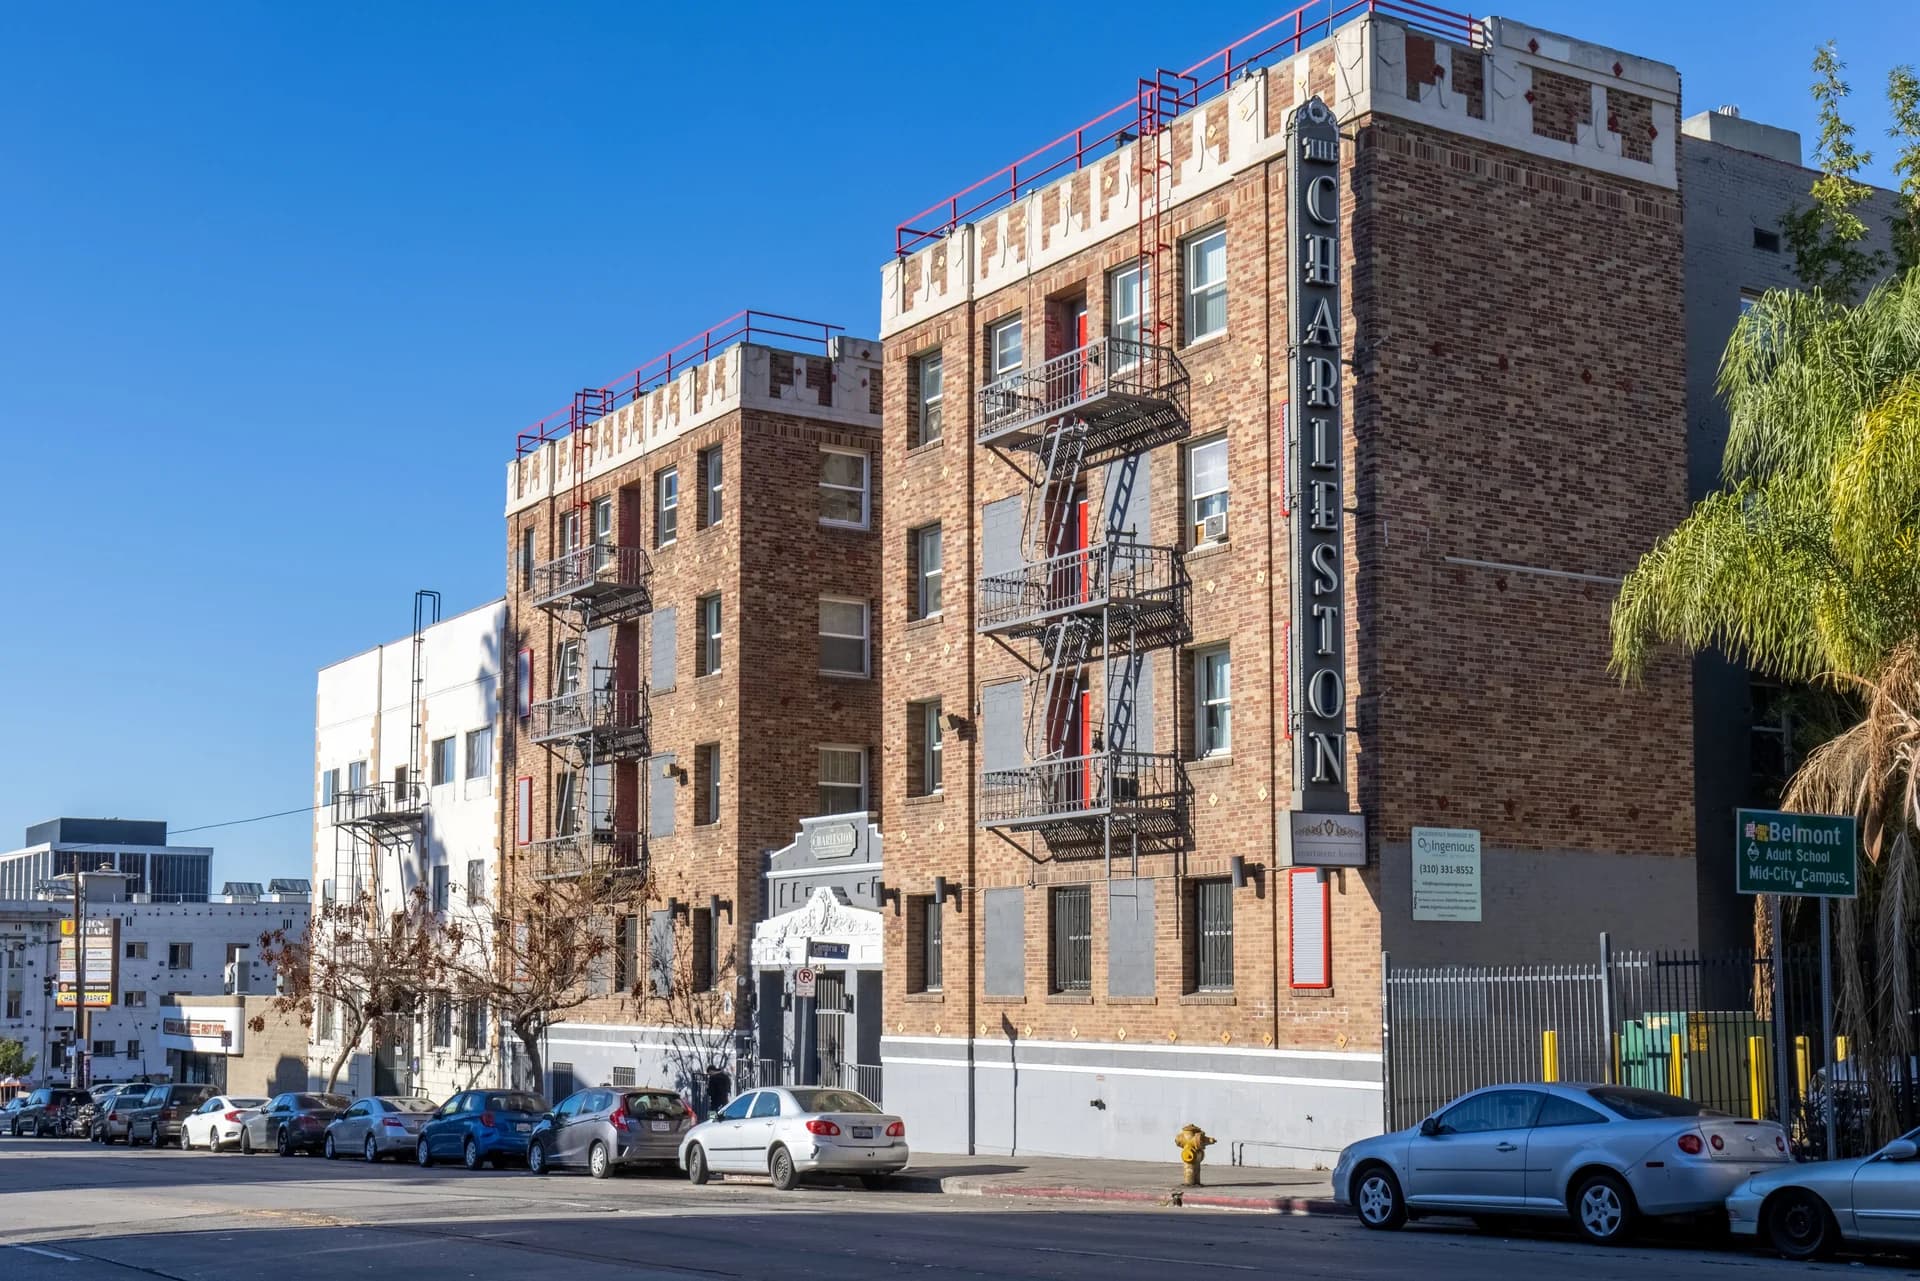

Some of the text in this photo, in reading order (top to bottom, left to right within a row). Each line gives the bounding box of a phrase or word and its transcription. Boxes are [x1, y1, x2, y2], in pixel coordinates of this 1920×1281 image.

[1302, 136, 1338, 162] THE
[1303, 174, 1344, 786] CHARLESTON
[1769, 822, 1841, 846] Belmont
[1431, 838, 1475, 854] Ingenious
[1766, 847, 1830, 864] Adult School
[1419, 864, 1474, 876] (310) 331-8552
[1749, 864, 1846, 887] Mid-City Campus
